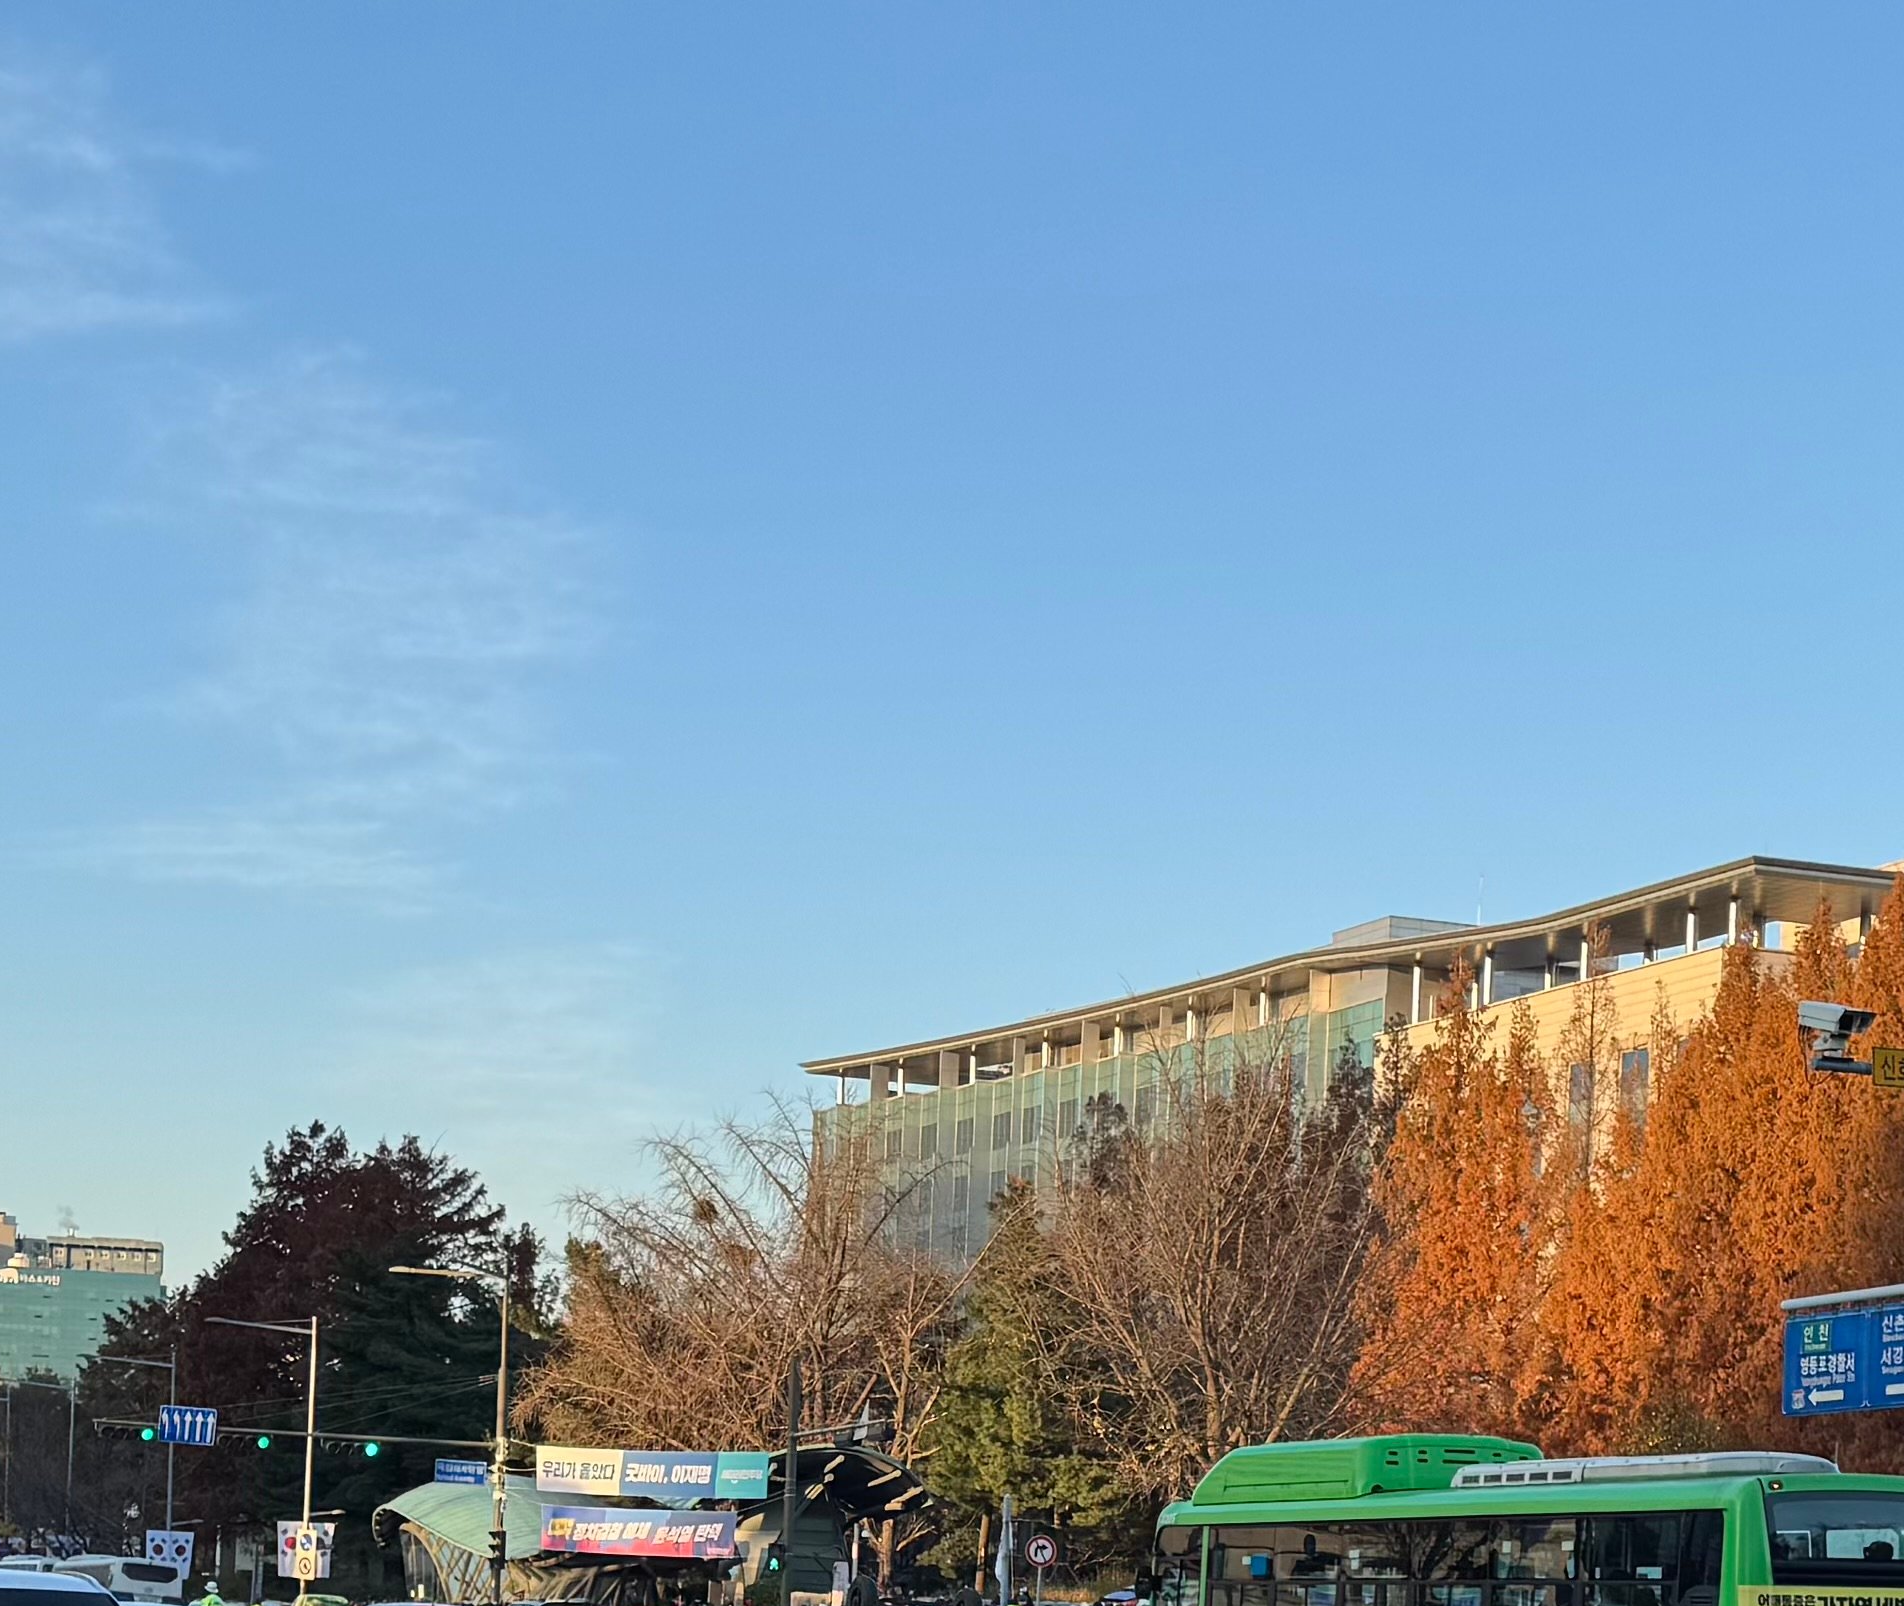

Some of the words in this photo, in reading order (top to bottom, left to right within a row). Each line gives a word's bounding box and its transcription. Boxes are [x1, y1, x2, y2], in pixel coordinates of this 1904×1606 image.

[1803, 1323, 1830, 1345] 인천
[1800, 1352, 1856, 1376] 영등포경찰서
[542, 1461, 576, 1480] 우리가
[670, 1465, 712, 1484] 이재명
